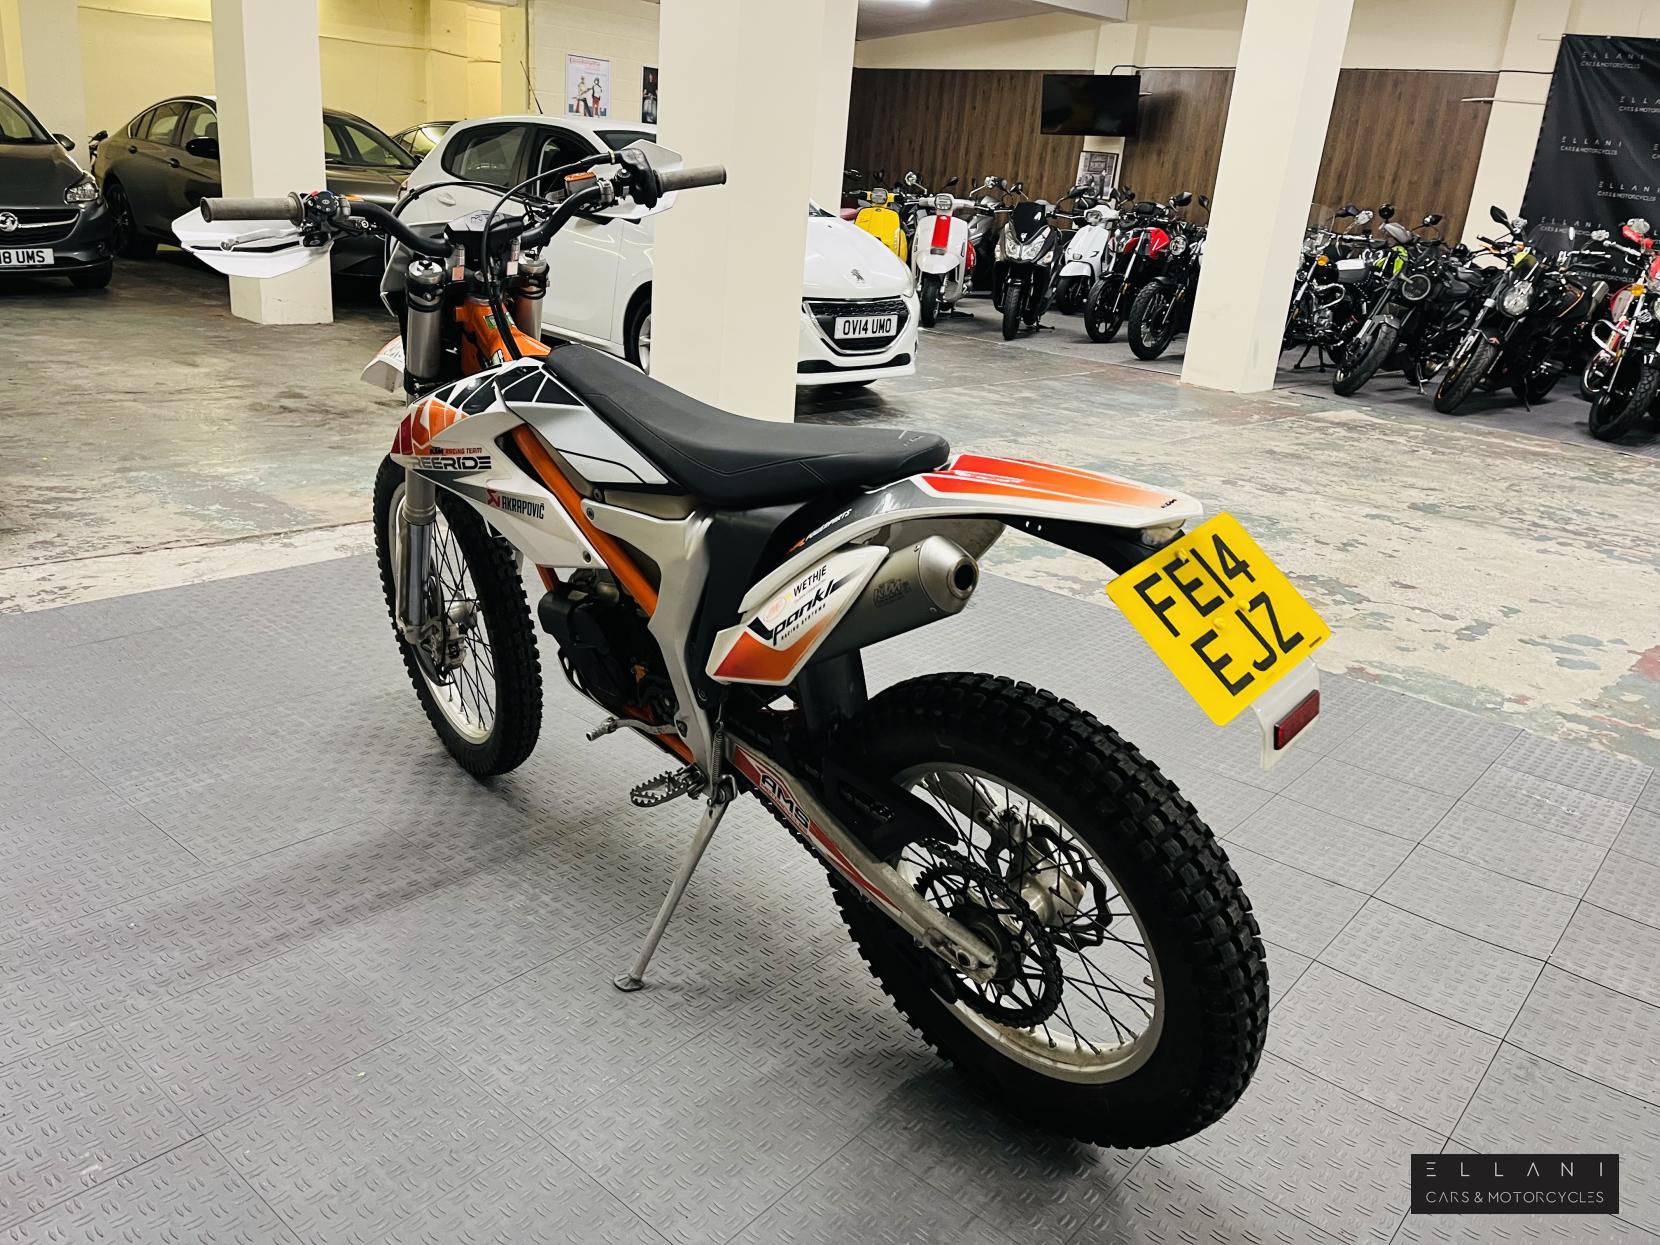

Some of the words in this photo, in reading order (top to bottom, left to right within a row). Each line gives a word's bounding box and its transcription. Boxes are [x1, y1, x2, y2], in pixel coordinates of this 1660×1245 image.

[1561, 136, 1622, 147] ELLANI
[16, 250, 45, 264] UMS
[843, 319, 868, 335] OV14
[872, 318, 892, 334] UMO
[404, 455, 492, 470] REERIDE
[501, 495, 545, 520] AKRAPOVIČ
[793, 564, 827, 597] WETHJE
[1134, 533, 1256, 638] FE14
[1190, 591, 1304, 696] EJZ
[761, 773, 810, 829] AMS
